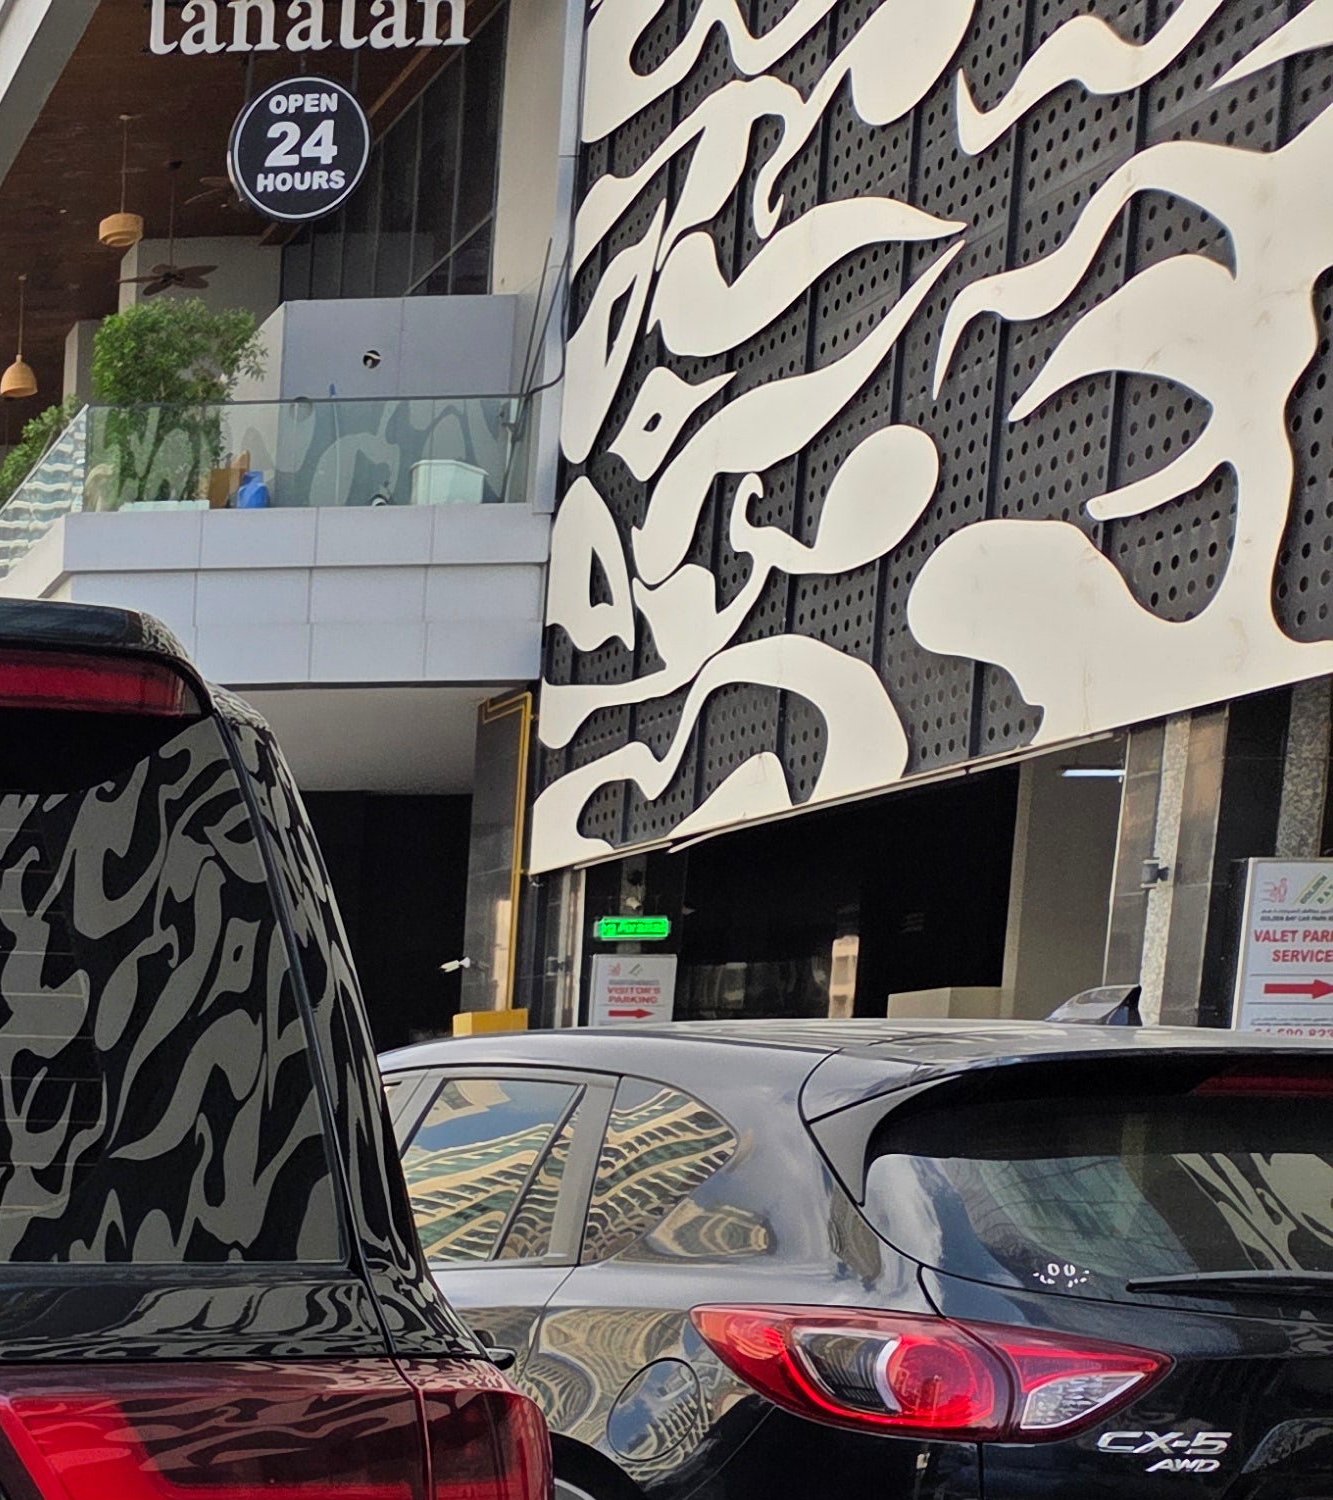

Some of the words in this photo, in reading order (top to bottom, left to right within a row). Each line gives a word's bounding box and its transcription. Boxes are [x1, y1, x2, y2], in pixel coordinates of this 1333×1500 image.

[268, 93, 338, 115] OPEN
[264, 119, 338, 168] 24
[256, 170, 346, 194] HOURS
[1253, 929, 1299, 943] VALET
[1096, 1431, 1233, 1455] CX-5
[1145, 1458, 1221, 1473] AWD
